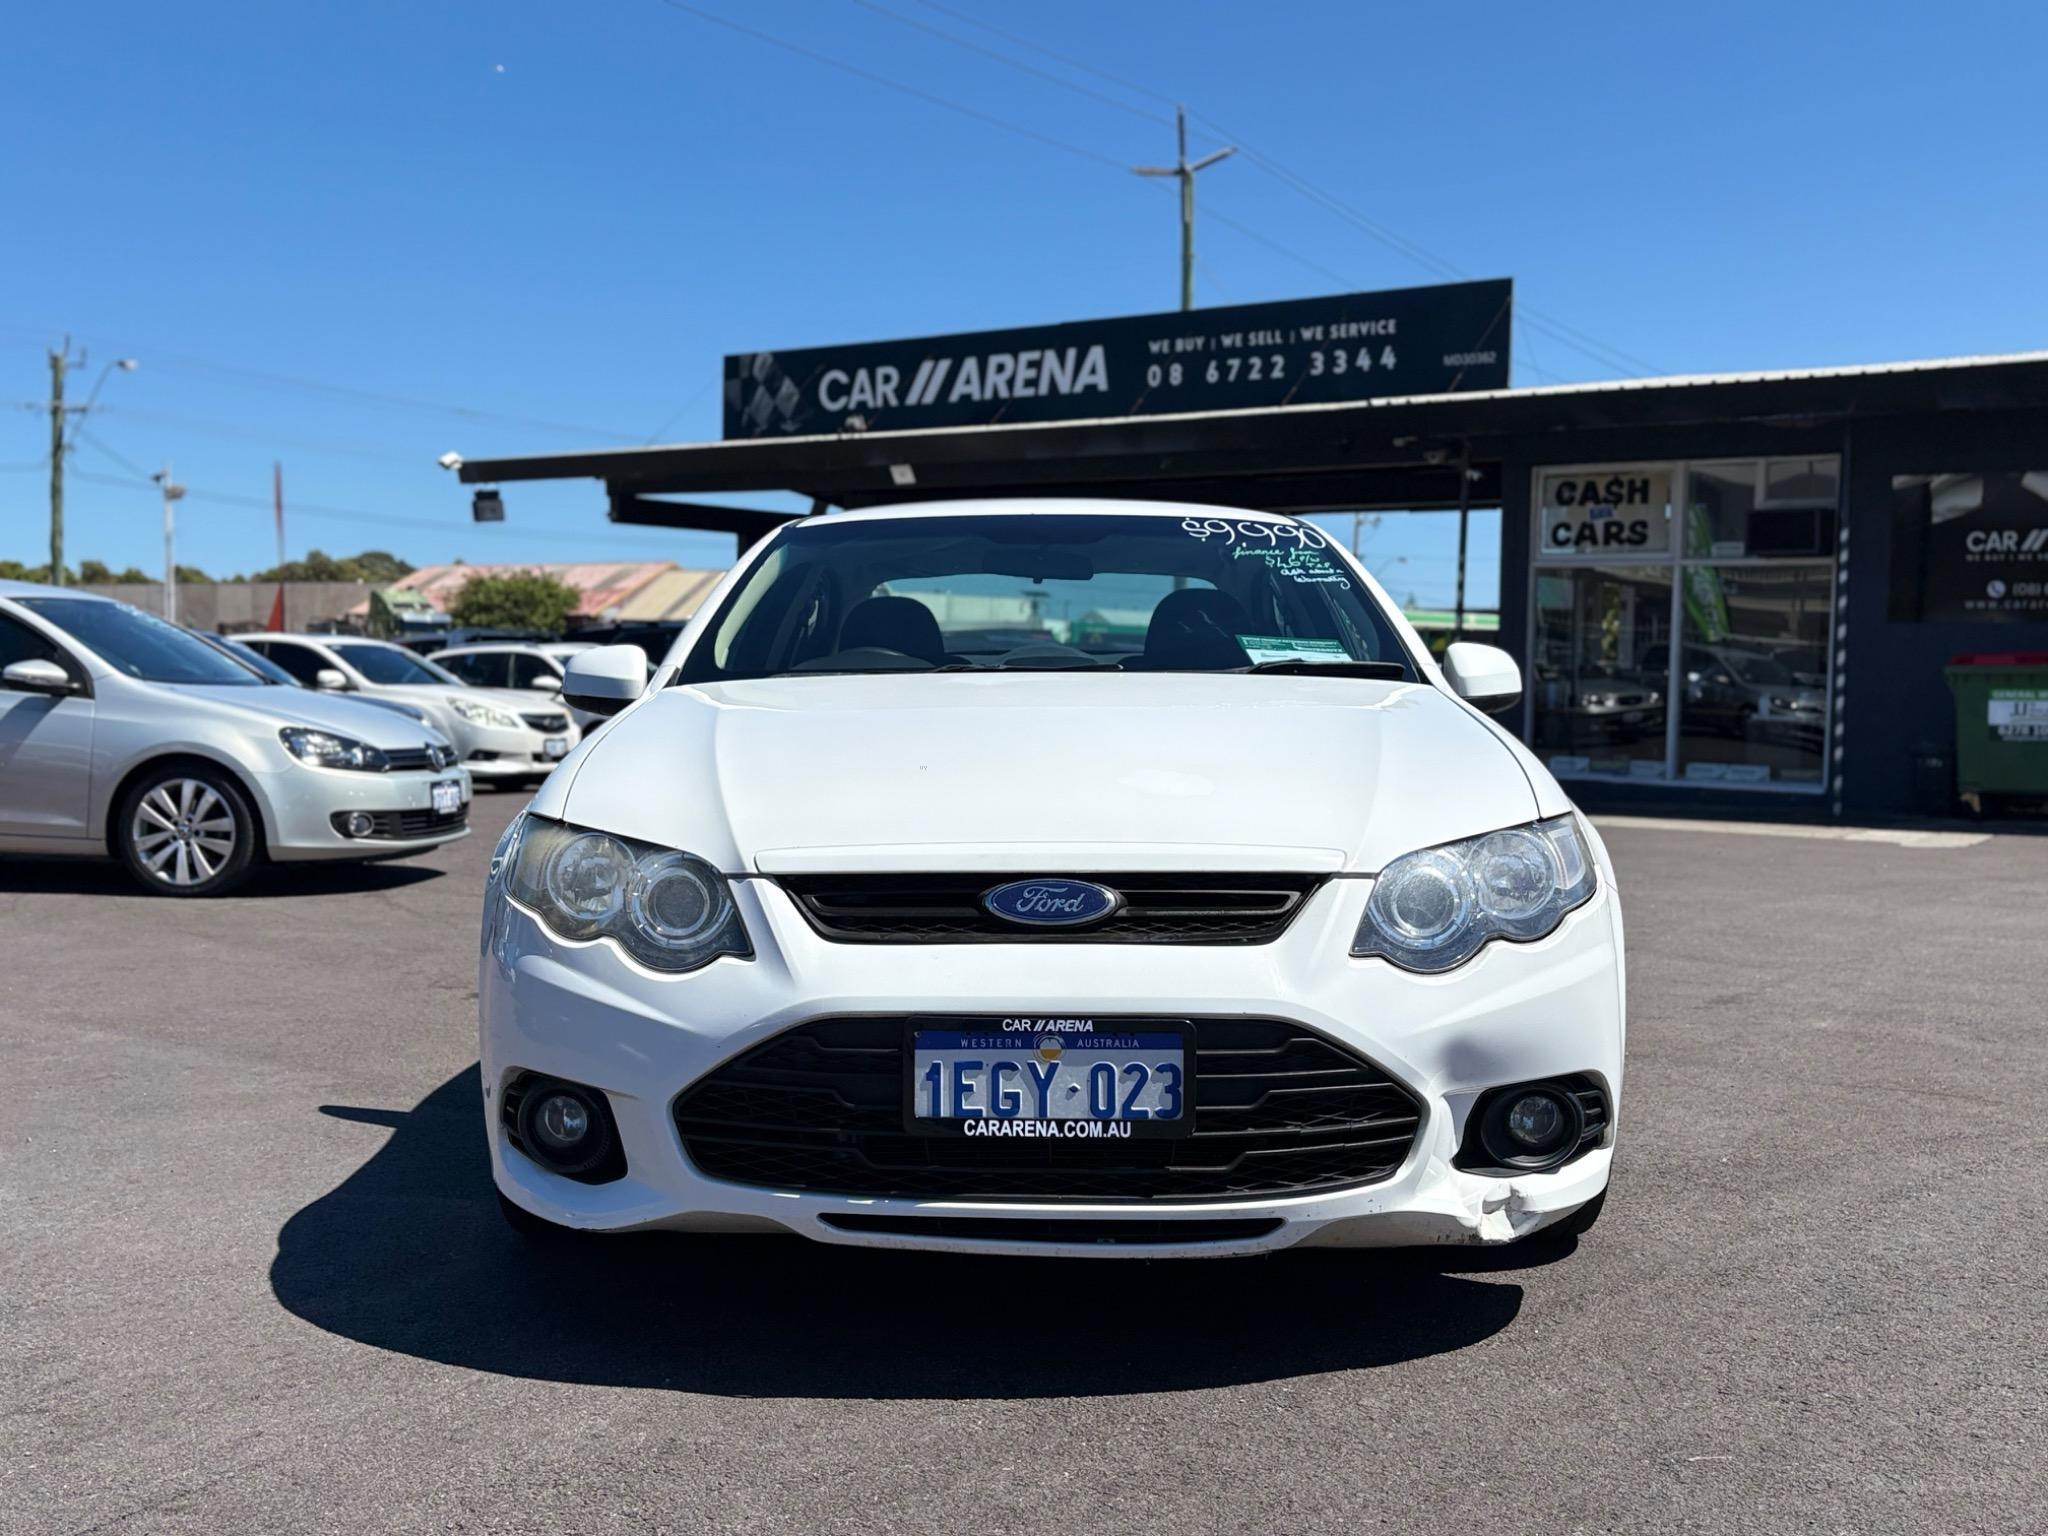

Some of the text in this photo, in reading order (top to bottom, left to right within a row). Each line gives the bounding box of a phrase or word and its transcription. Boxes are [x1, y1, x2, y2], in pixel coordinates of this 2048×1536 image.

[1149, 319, 1397, 354] WE BUY WE SELL WE SERVICE
[1147, 346, 1397, 387] 08 6722 3344
[818, 365, 900, 412] CAR
[1552, 520, 1649, 547] CARS
[1965, 530, 2019, 552] CAR
[1016, 886, 1086, 912] Ford
[1002, 1019, 1031, 1032] CAR
[960, 1038, 1140, 1049] WESTERN AUSTRALIA
[964, 1119, 1132, 1138] CARARENA.COM.AU
